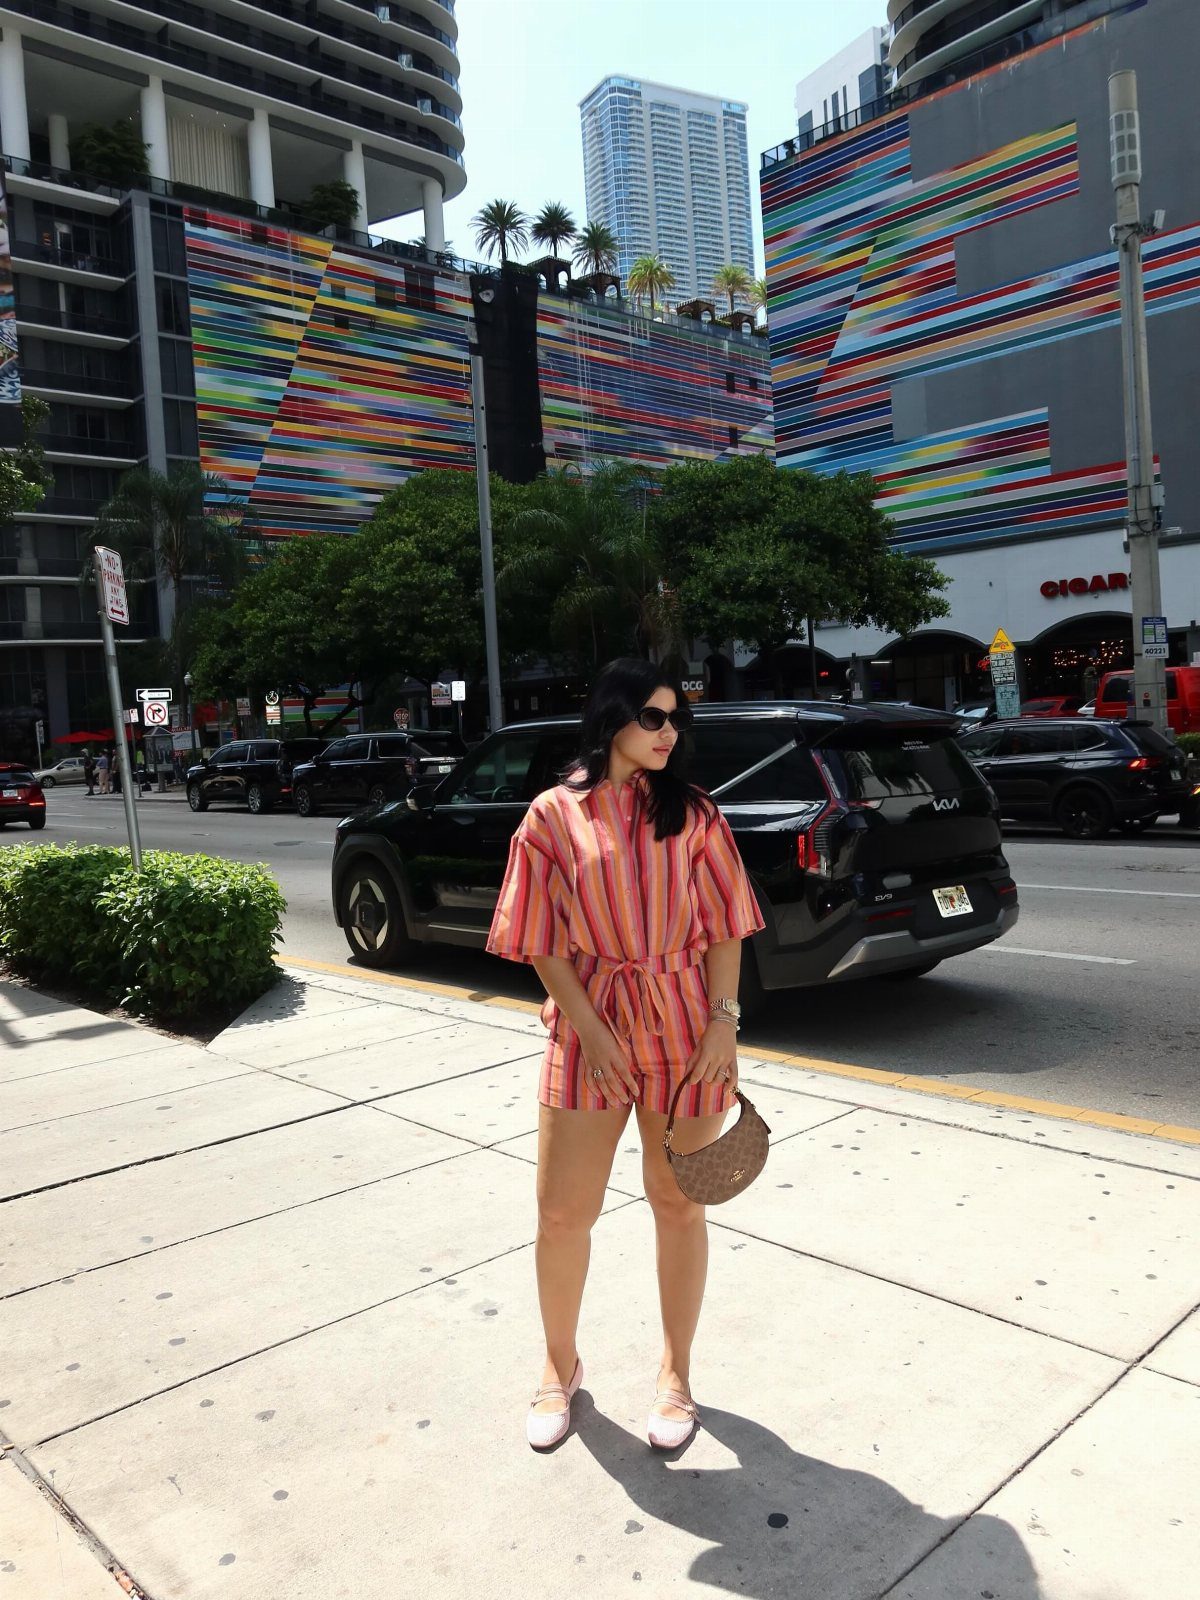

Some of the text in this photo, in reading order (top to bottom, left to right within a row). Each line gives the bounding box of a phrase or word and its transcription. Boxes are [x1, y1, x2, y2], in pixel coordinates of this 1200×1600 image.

[106, 555, 117, 570] NO
[103, 569, 124, 588] PARKING
[1040, 572, 1131, 599] CIGAR
[933, 798, 960, 811] KIA
[874, 893, 894, 902] EV9
